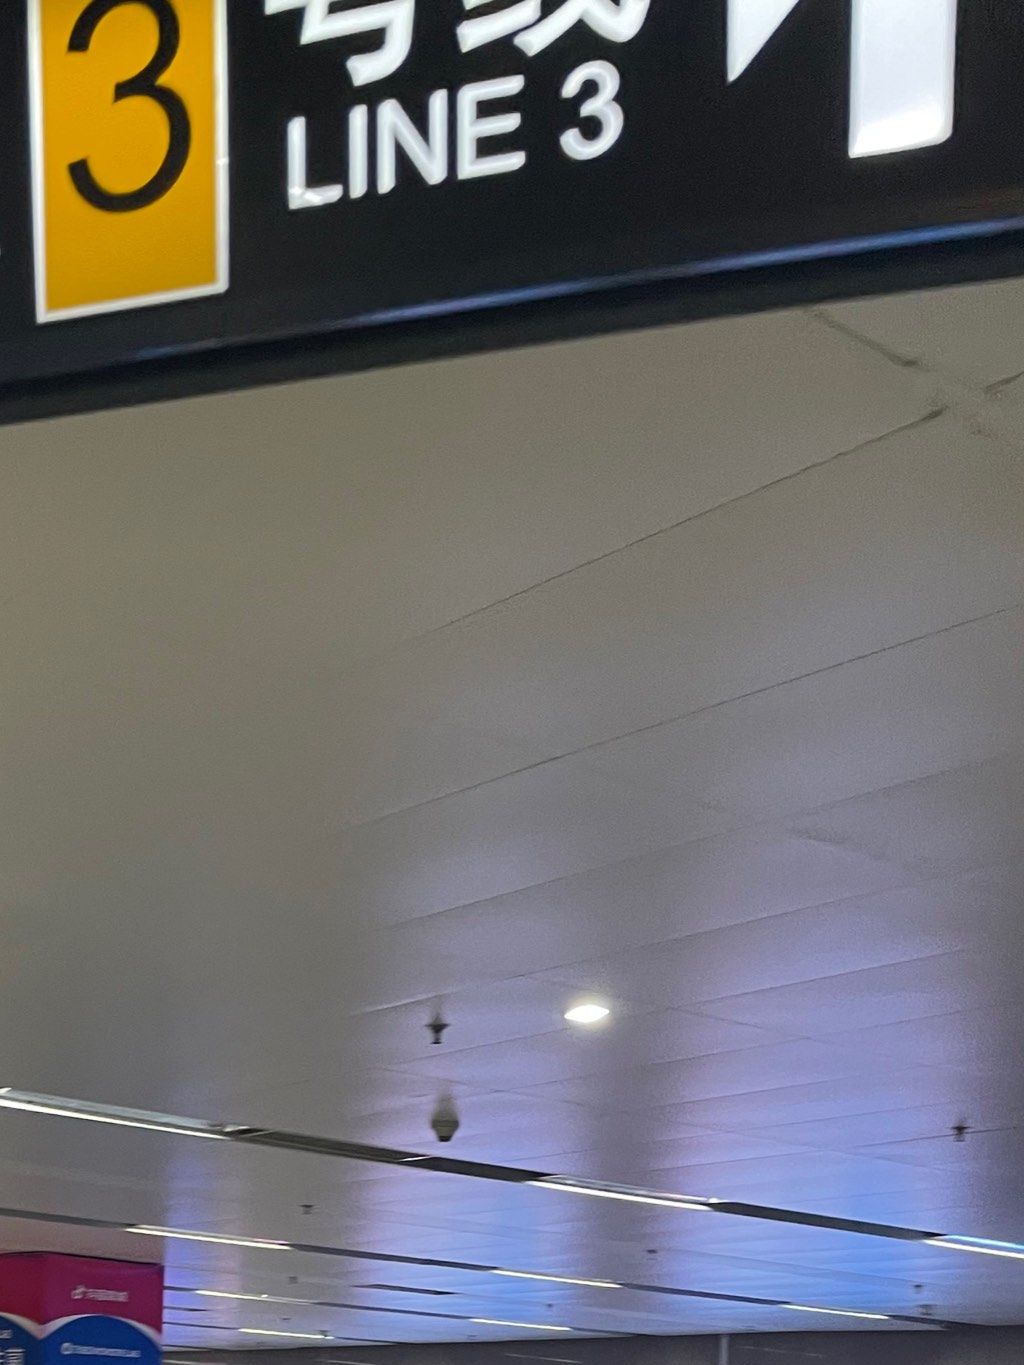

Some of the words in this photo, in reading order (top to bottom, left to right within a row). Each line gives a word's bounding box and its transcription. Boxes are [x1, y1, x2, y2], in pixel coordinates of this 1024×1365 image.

[66, 0, 192, 215] 3
[287, 74, 526, 211] LINE
[559, 59, 626, 161] 3
